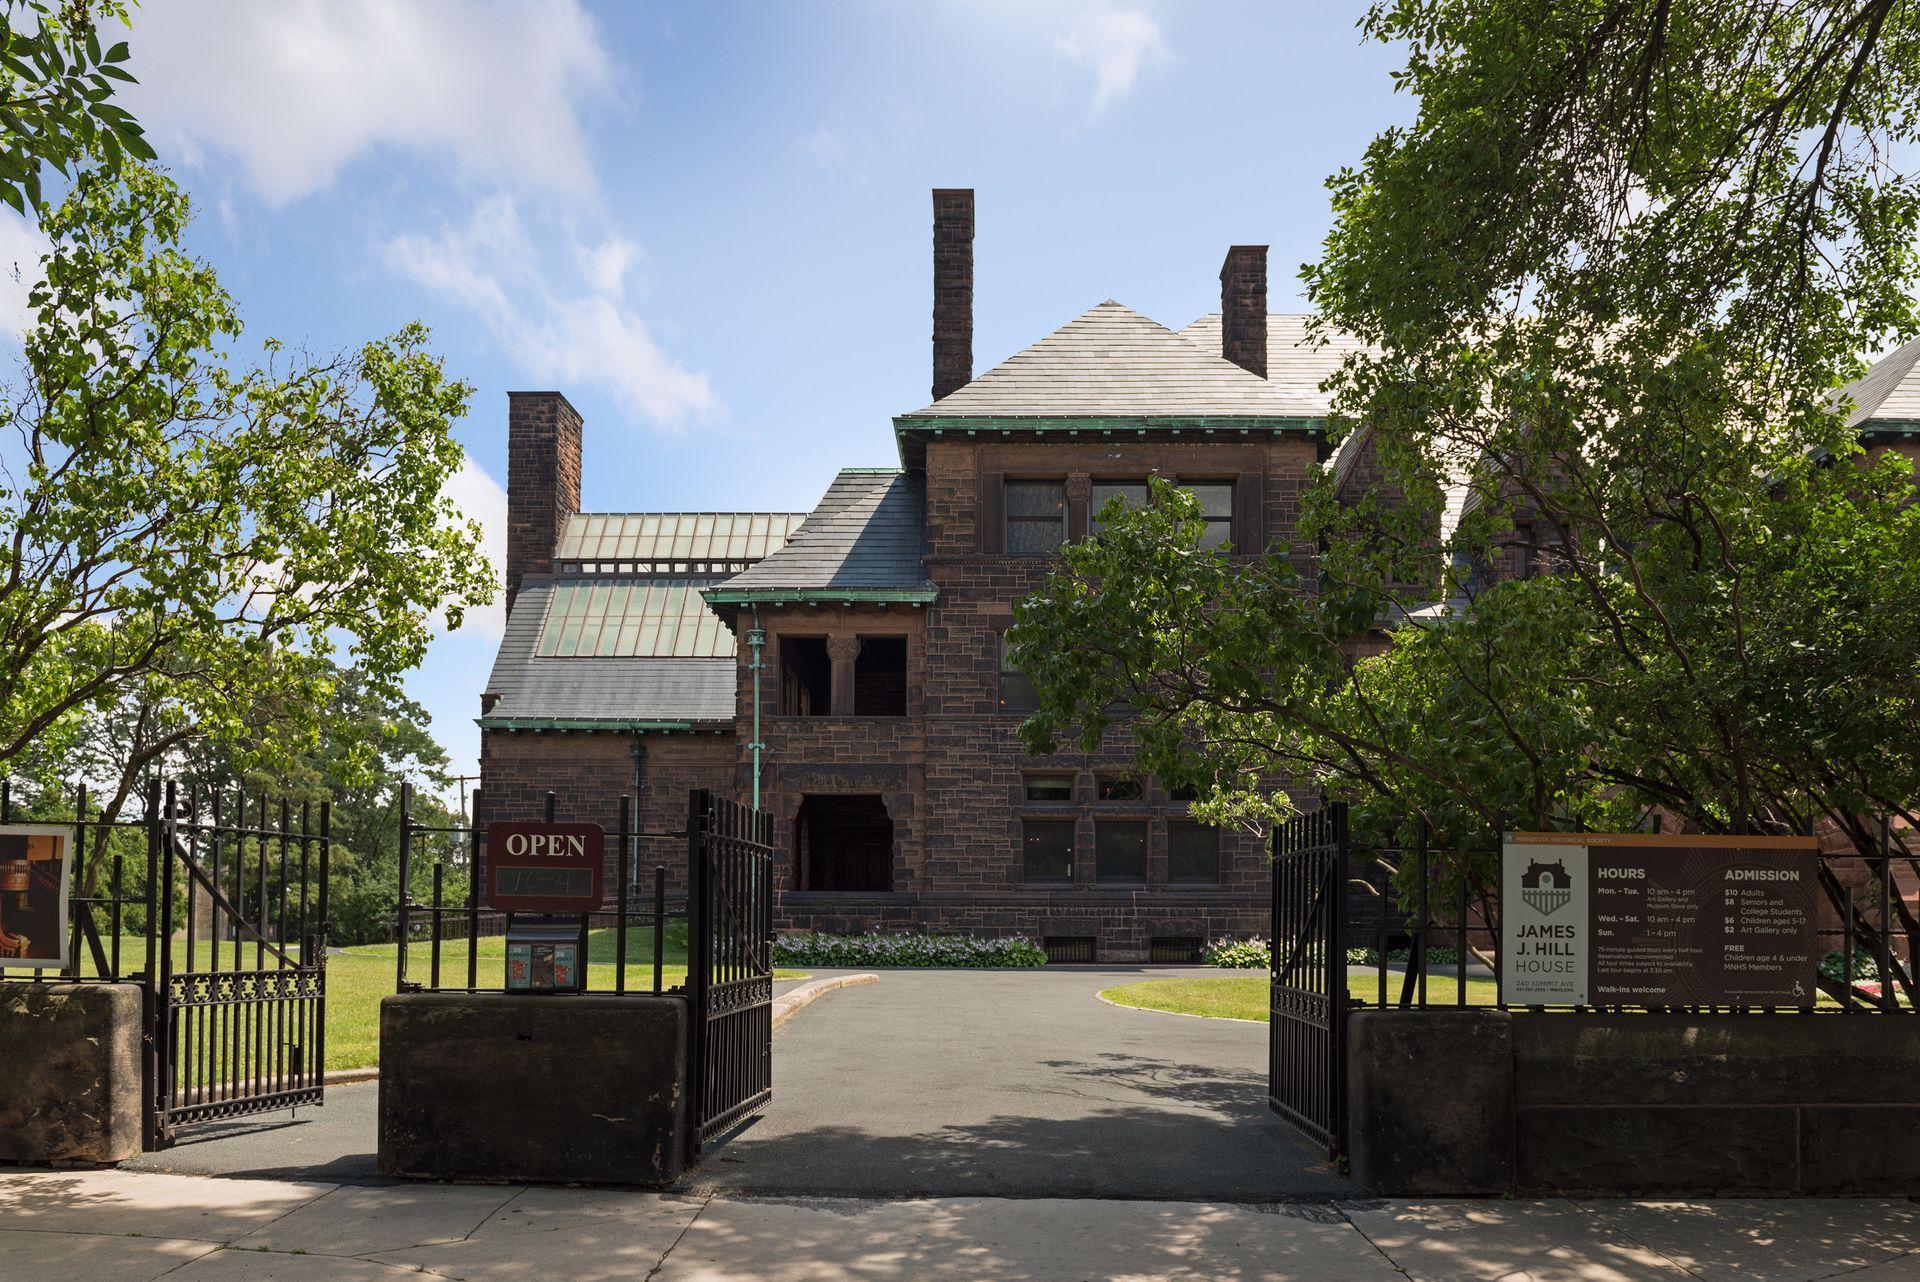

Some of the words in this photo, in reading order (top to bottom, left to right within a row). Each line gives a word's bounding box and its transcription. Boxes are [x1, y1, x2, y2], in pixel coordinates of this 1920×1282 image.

[506, 834, 586, 857] OPEN
[1597, 867, 1646, 879] HOURS
[1724, 869, 1800, 881] ADMISSION
[1741, 889, 1764, 897] Adults
[1724, 898, 1735, 906] $8
[1740, 898, 1768, 906] Seniors
[1740, 908, 1769, 916] College
[1516, 924, 1575, 939] JAMES
[1597, 928, 1615, 936] Sun.
[1724, 926, 1735, 934] $2
[1754, 927, 1780, 935] Gallery
[1781, 927, 1798, 935] only
[1516, 942, 1530, 955] J.
[1535, 942, 1575, 956] HILL
[1515, 960, 1575, 973] HOUSE
[1748, 963, 1783, 971] Members
